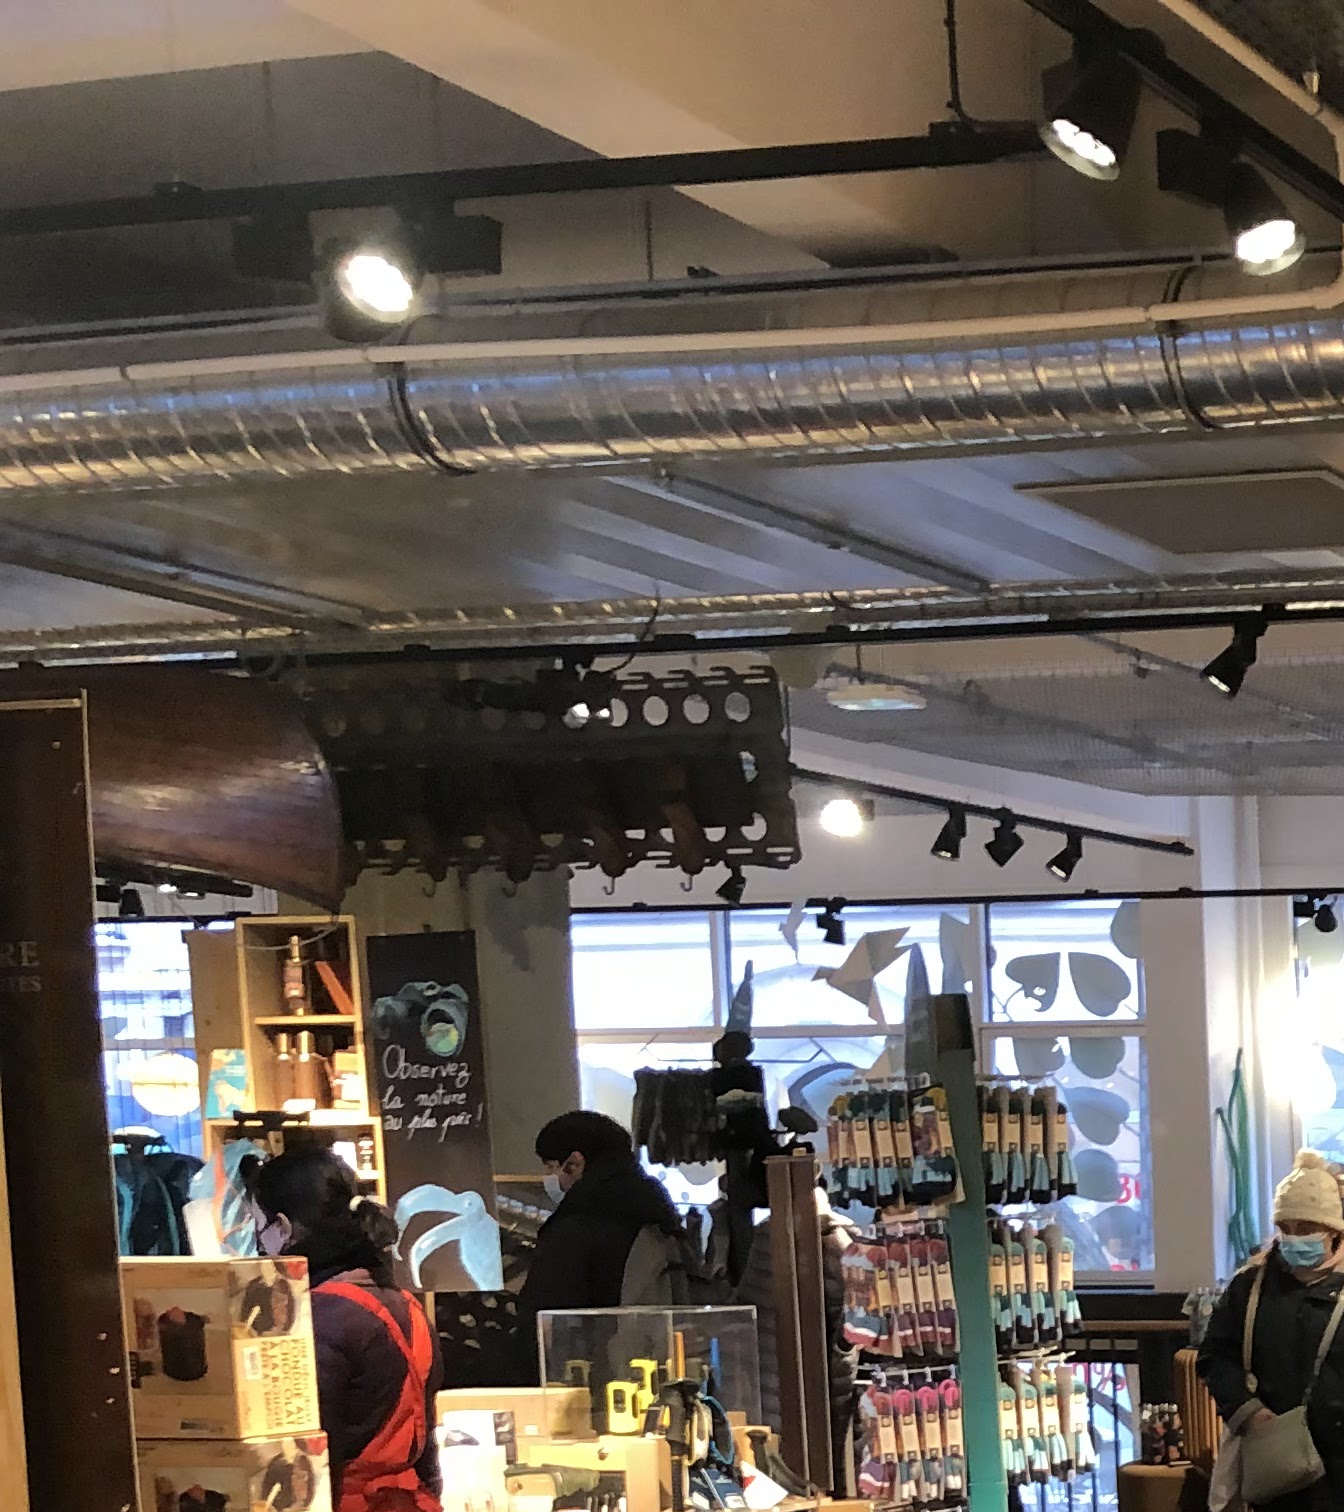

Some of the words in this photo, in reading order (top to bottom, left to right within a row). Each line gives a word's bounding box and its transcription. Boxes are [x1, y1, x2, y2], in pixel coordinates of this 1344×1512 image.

[382, 1044, 472, 1089] Observez
[281, 1339, 296, 1425] CHOCOLAT
[291, 1339, 304, 1399] FONDUE
[295, 1406, 305, 1425] AU
